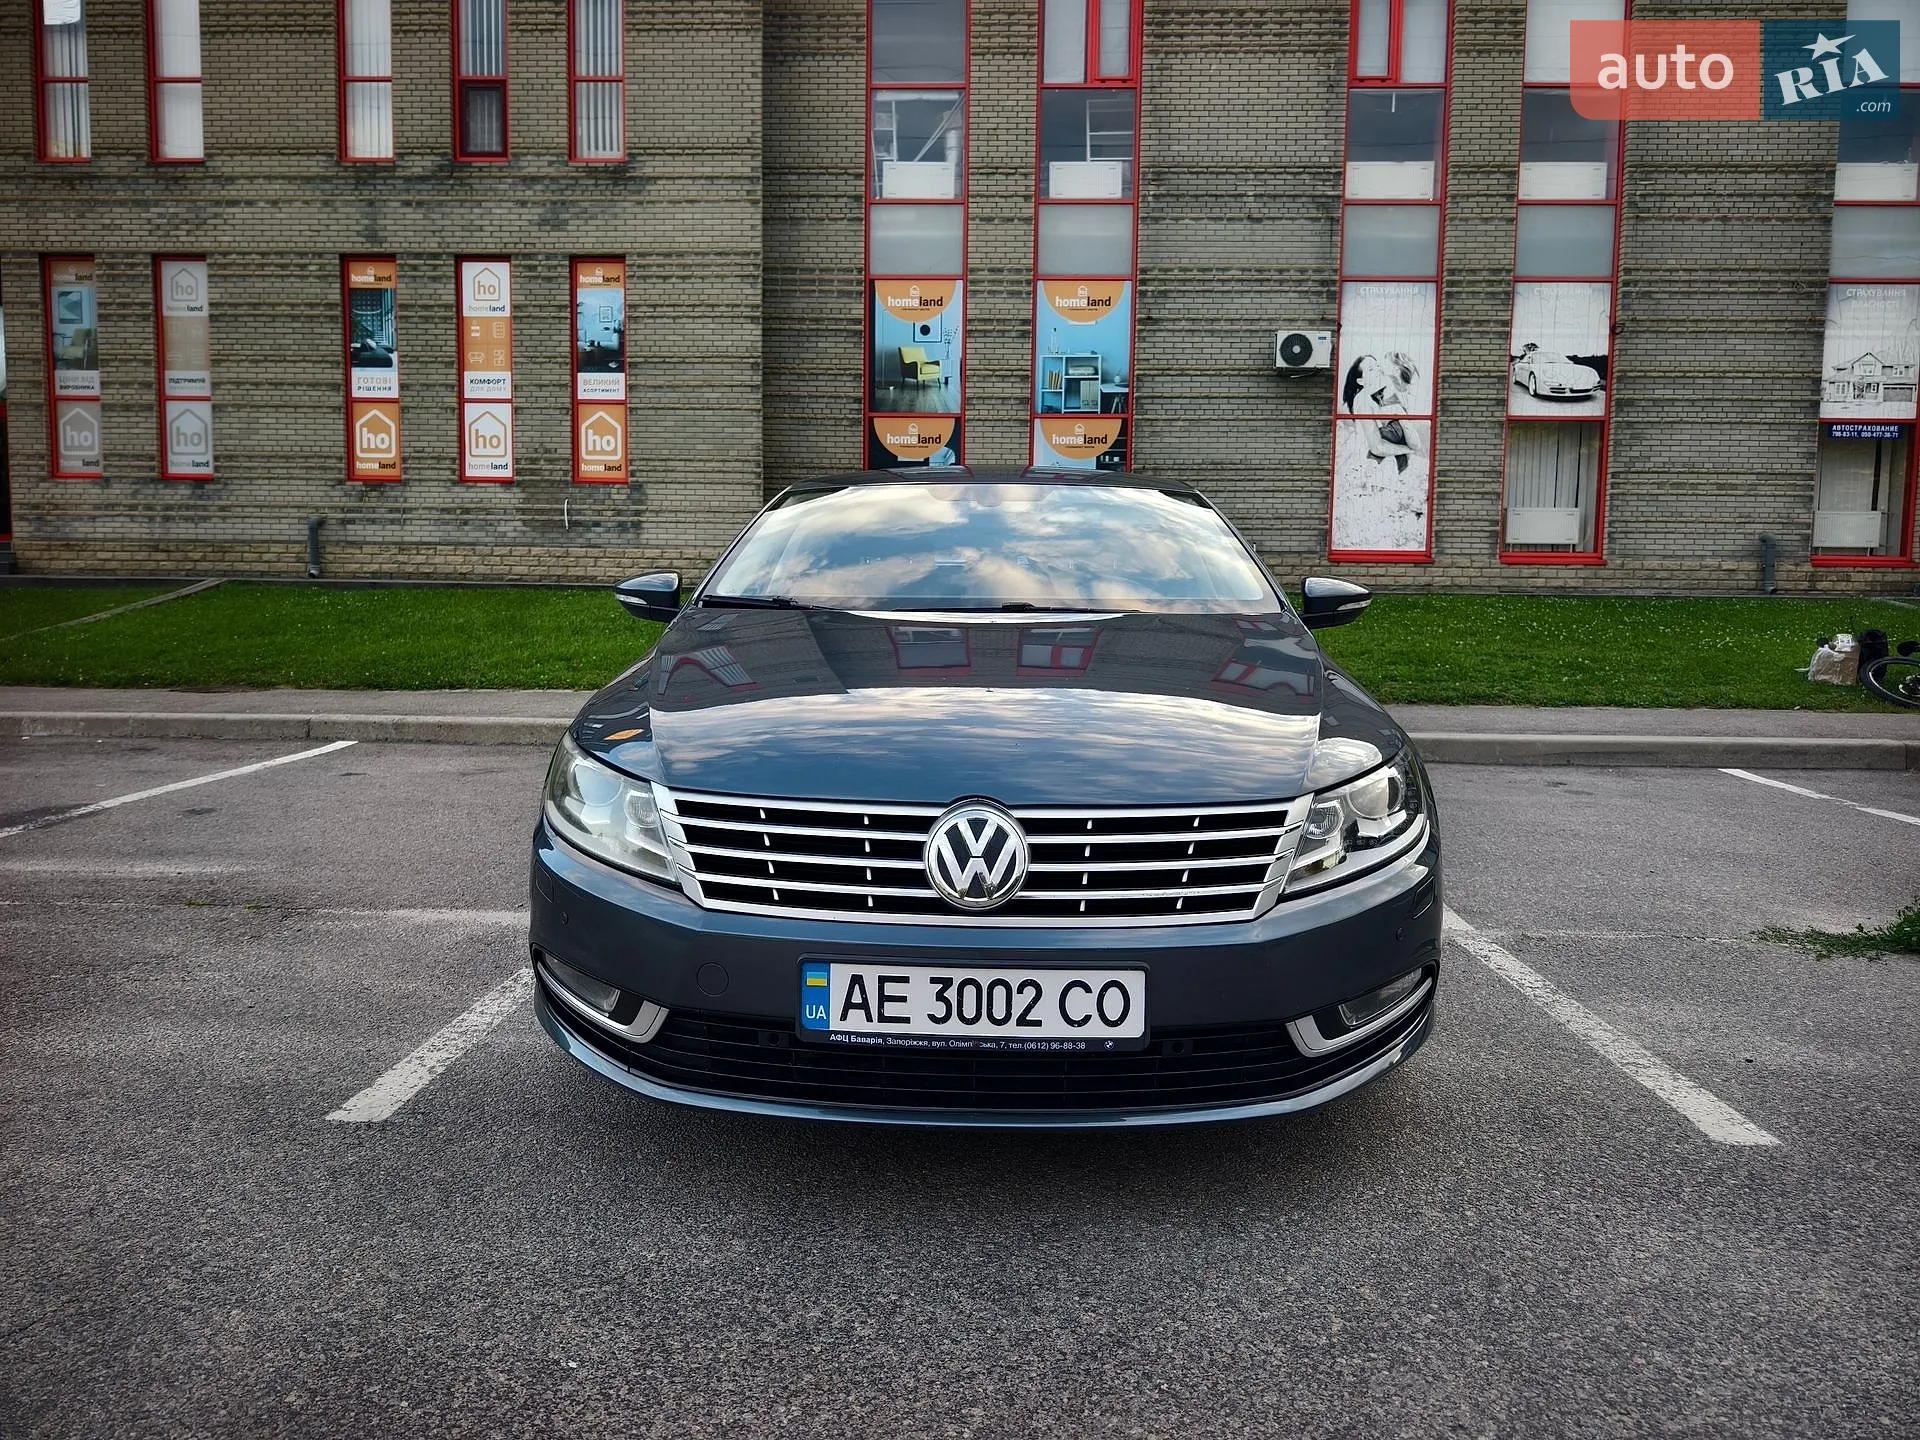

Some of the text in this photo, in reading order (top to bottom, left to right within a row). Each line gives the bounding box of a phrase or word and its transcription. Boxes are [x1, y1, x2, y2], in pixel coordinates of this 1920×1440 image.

[351, 273, 392, 283] homeland
[580, 274, 621, 284] homeland
[175, 280, 194, 297] ho
[477, 280, 497, 296] ho
[887, 296, 944, 308] homeland
[1055, 296, 1112, 308] homeland
[468, 304, 506, 313] homeland
[357, 376, 391, 385] ГОТОВІ
[66, 425, 93, 447] ho
[176, 425, 202, 448] ho
[362, 427, 390, 450] ho
[475, 429, 501, 450] ho
[587, 429, 615, 451] ho
[887, 434, 942, 446] homeland
[1052, 434, 1108, 446] homeland
[356, 460, 397, 470] homeland
[468, 461, 509, 471] homeland
[581, 463, 622, 473] homeland
[839, 973, 1131, 1029] AE 3002 CO
[805, 1005, 827, 1020] UA
[829, 1033, 849, 1044] АФЦ
[850, 1035, 885, 1045] Баварія,
[931, 1040, 948, 1049] вул.
[948, 1039, 998, 1050] Олімпська,
